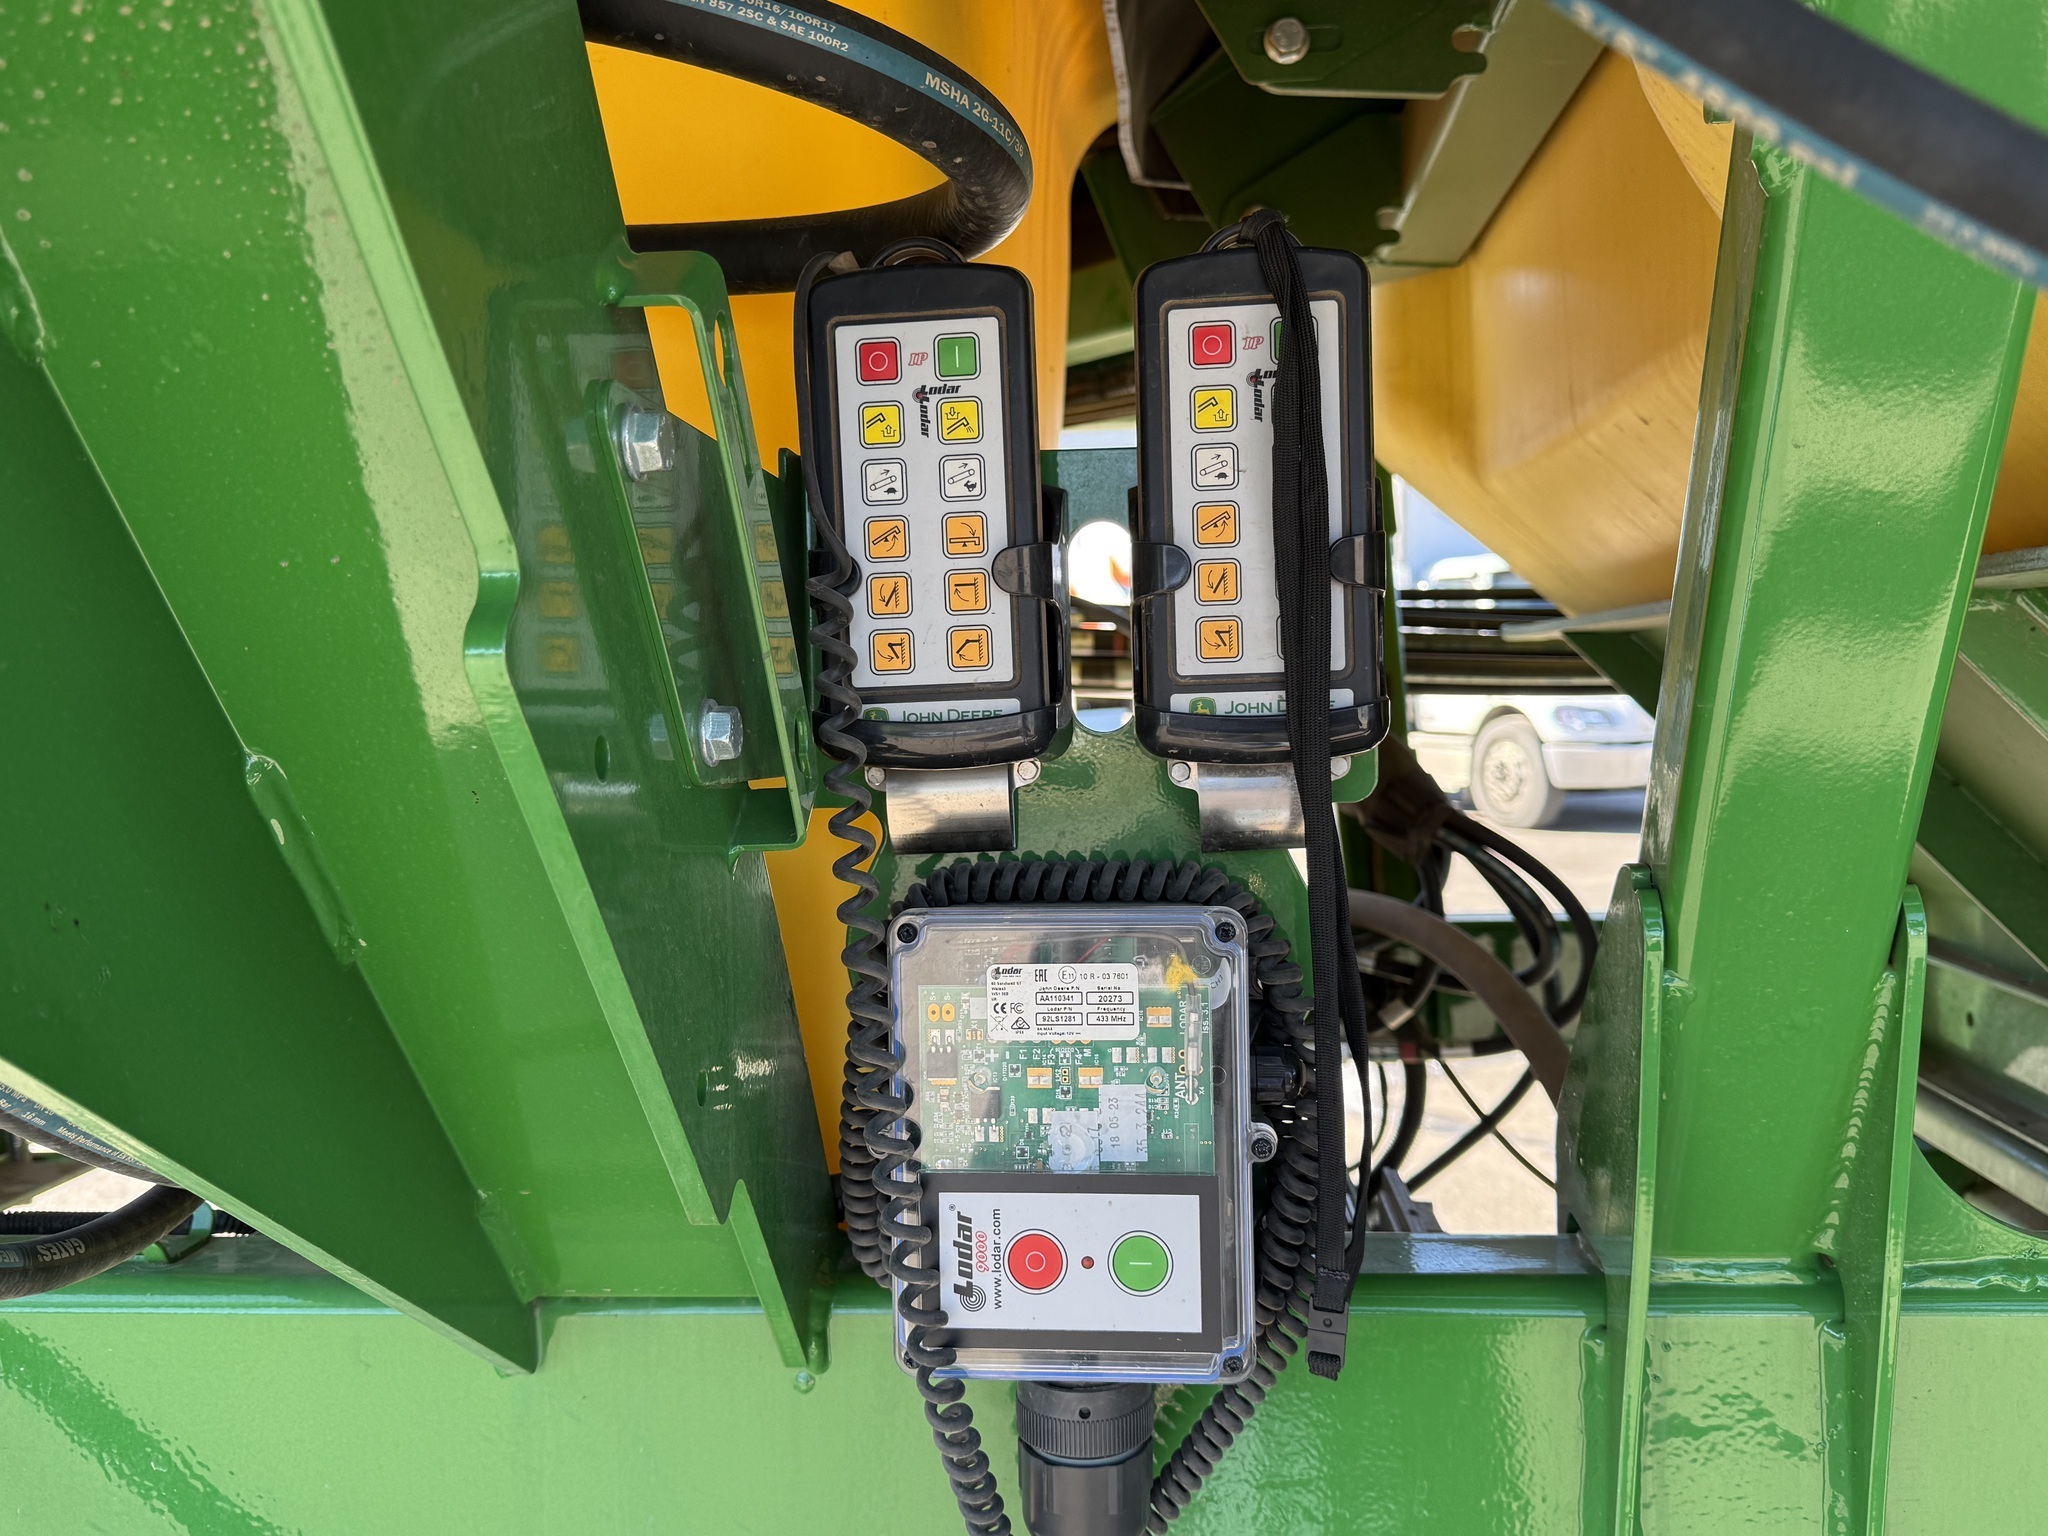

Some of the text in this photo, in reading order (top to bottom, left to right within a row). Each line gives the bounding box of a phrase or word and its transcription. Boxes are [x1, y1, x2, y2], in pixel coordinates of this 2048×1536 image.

[737, 6, 764, 21] 2SC
[766, 15, 777, 26] &
[780, 20, 805, 36] SAE
[808, 30, 849, 52] 100R2
[741, 0, 837, 33] 0R16/100R17
[925, 71, 970, 110] MSHA
[908, 352, 929, 366] IP
[920, 383, 961, 396] Lodar
[1253, 380, 1265, 422] Lodar
[919, 396, 931, 438] Lodar
[902, 710, 942, 722] JOHN
[1224, 701, 1273, 715] JOHN
[1179, 1000, 1187, 1034] LODAR
[1019, 1049, 1027, 1060] F1
[1033, 1048, 1041, 1060] F2
[1083, 1048, 1091, 1056] M
[1174, 1072, 1186, 1099] ANT
[36, 1237, 86, 1262] GATES
[953, 1210, 974, 1298] Lodar
[975, 1230, 989, 1273] 9000
[991, 1208, 1002, 1310] www.lodar.com
